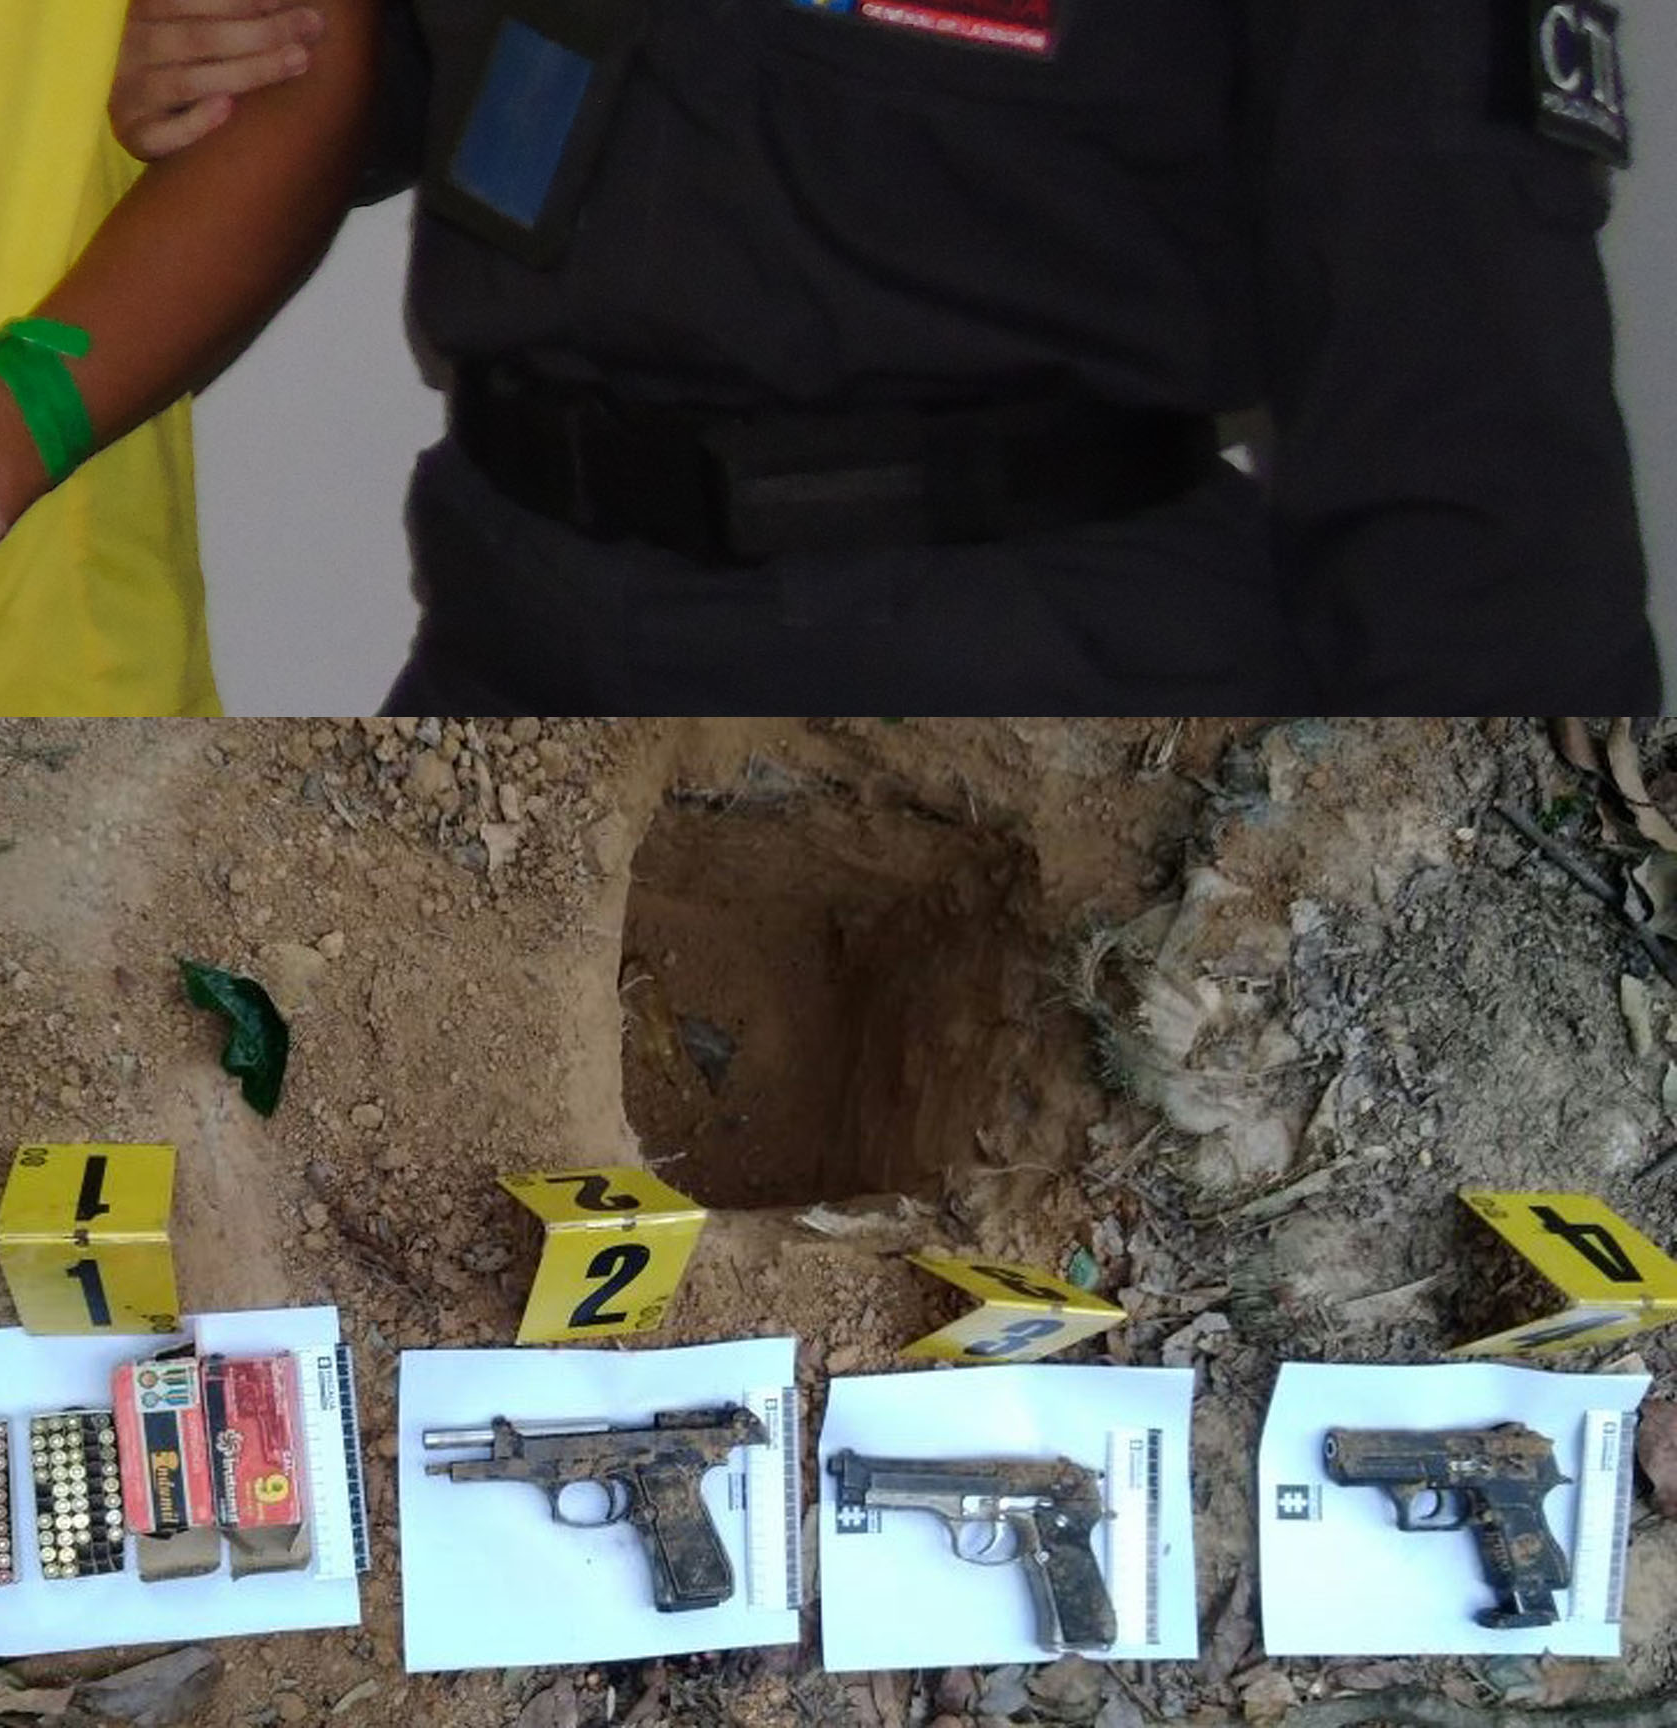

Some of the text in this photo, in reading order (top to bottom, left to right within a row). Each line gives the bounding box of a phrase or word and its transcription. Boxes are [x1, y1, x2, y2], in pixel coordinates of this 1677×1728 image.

[1529, 1206, 1644, 1283] 4
[66, 1259, 112, 1326] 1
[568, 1243, 651, 1328] 2
[254, 1471, 290, 1504] 9
